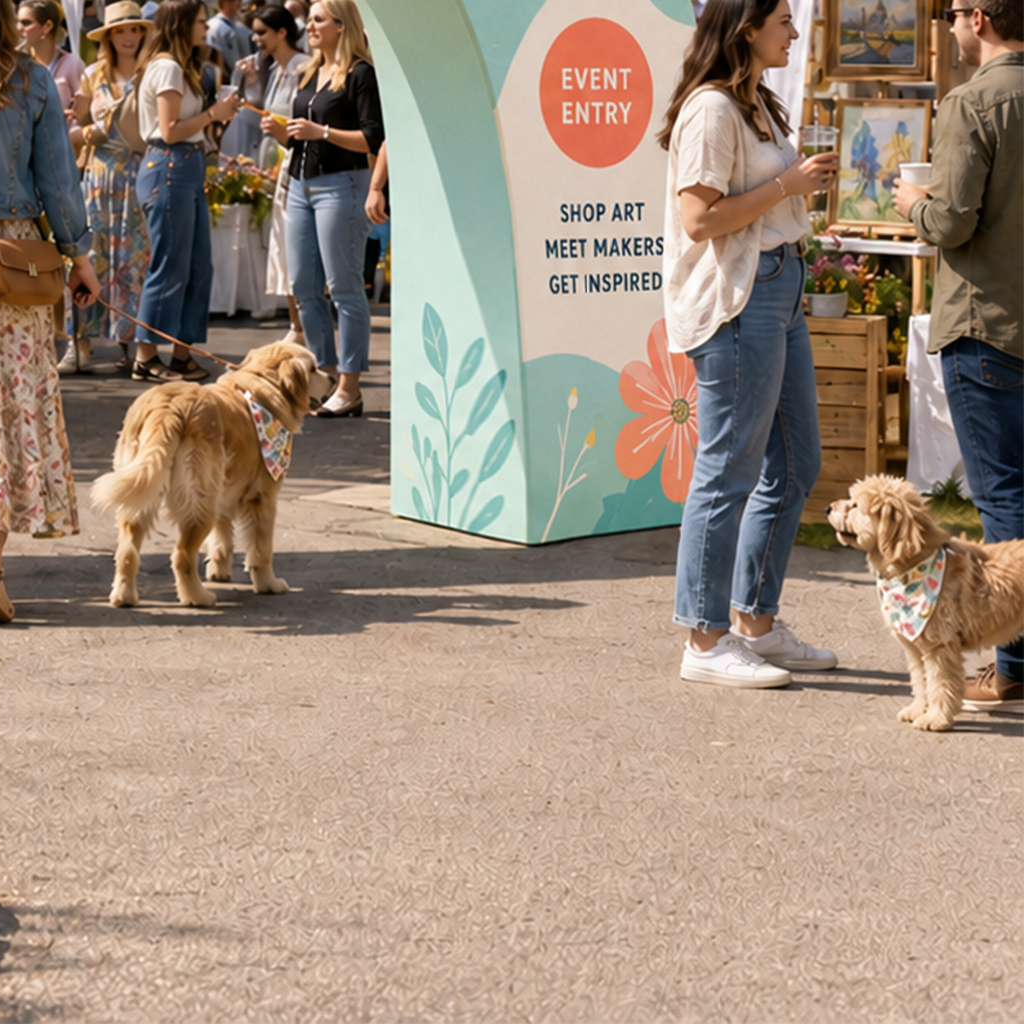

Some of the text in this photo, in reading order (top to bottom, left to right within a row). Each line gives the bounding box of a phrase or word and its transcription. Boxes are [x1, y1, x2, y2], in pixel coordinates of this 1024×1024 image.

[561, 67, 632, 90] EVENT
[562, 101, 632, 124] ENTRY
[560, 202, 645, 223] SHOP ART
[545, 236, 664, 259] MEET MAKERS
[549, 272, 663, 295] GET INSPIRED
